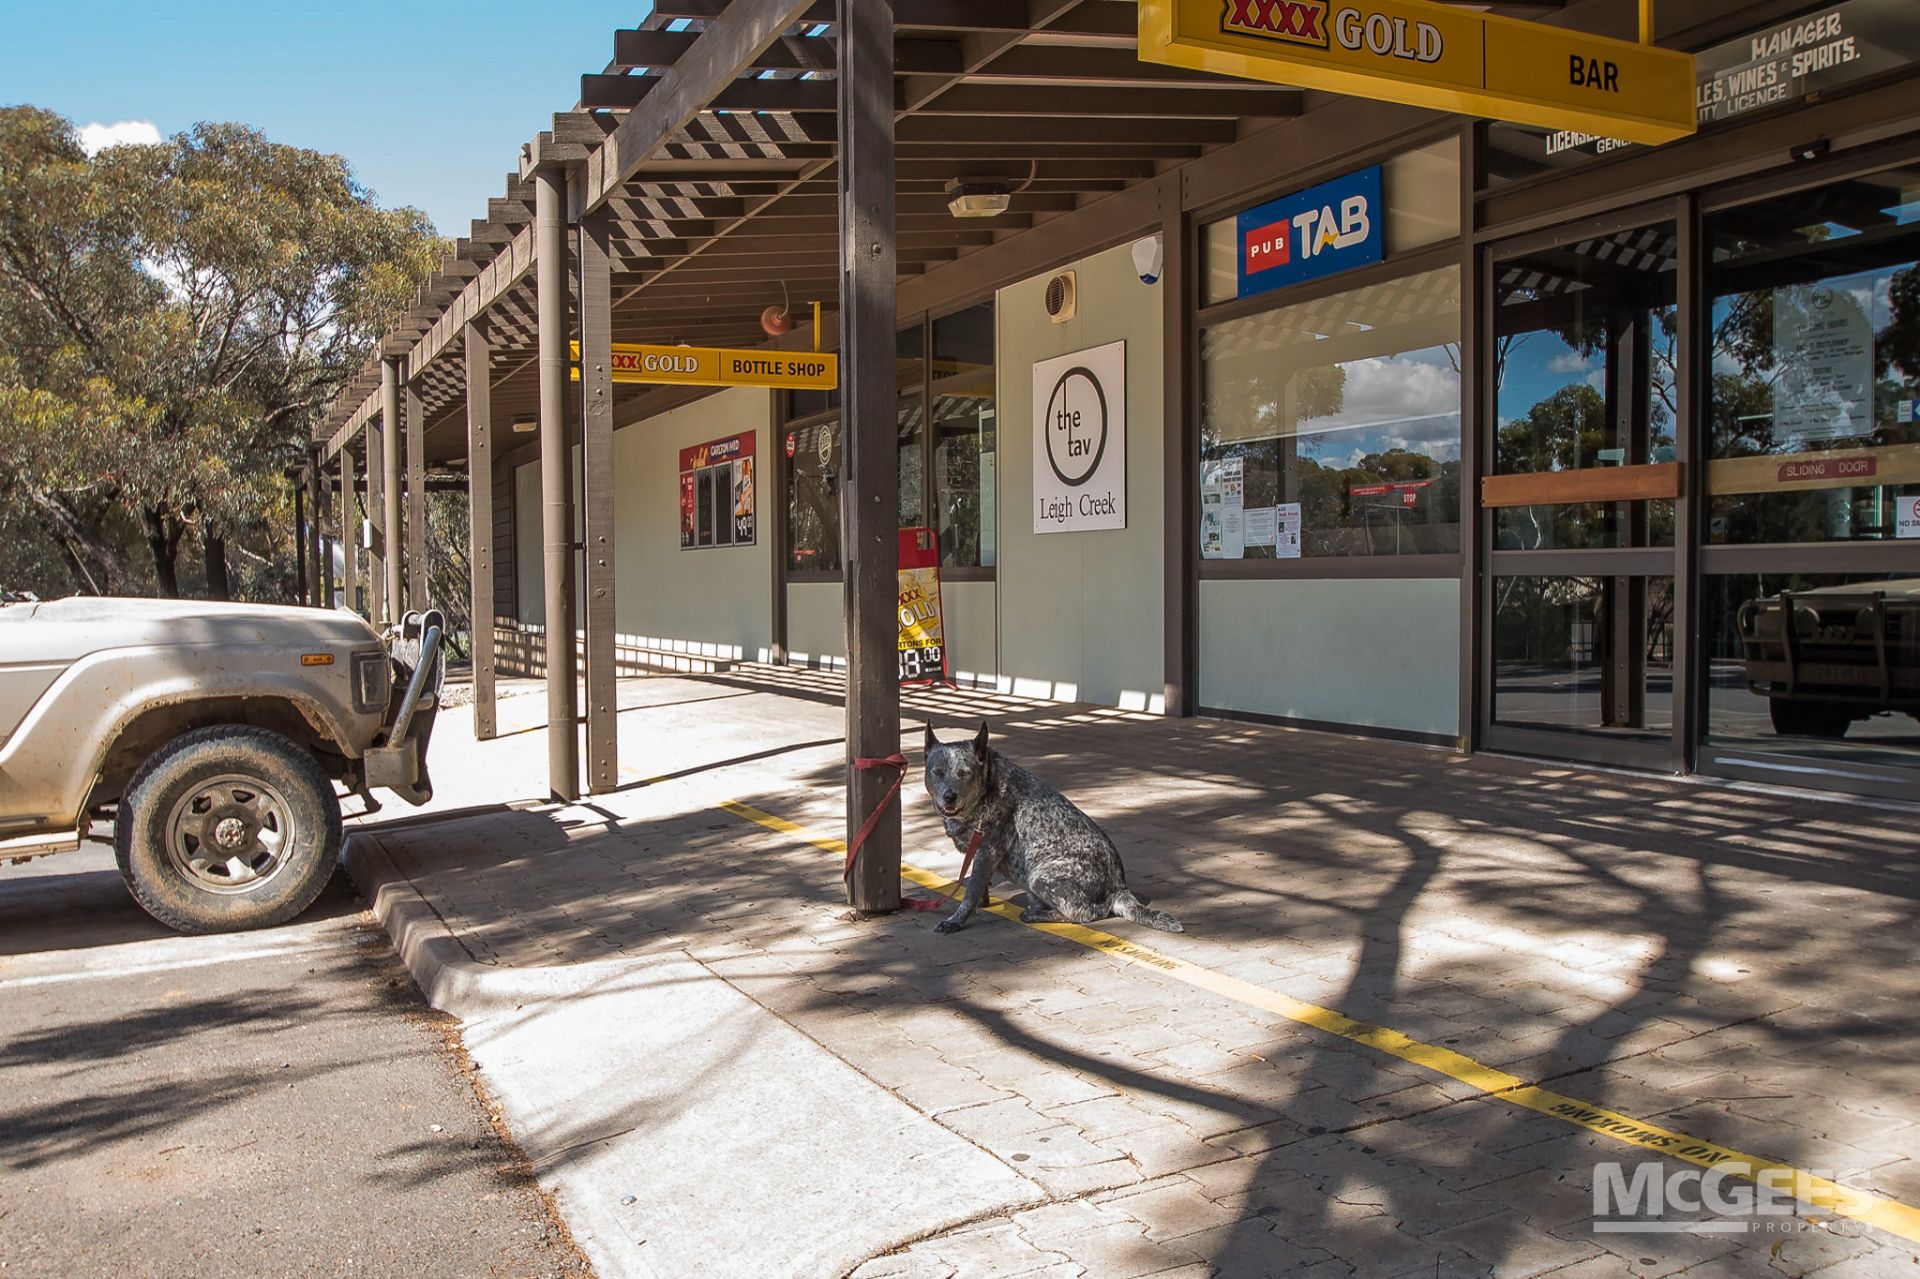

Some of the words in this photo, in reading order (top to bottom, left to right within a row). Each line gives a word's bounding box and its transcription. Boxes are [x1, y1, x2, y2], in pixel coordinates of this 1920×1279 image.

[1230, 0, 1321, 40] XXXX
[1335, 8, 1443, 63] GOLD
[1750, 12, 1842, 62] MANAGER
[1569, 54, 1620, 93] BAR
[1728, 61, 1777, 97] WINES
[1791, 36, 1861, 78] SPIRITS.
[1727, 82, 1787, 114] LICENCE
[1251, 237, 1284, 257] PUB
[1292, 195, 1370, 259] TAB
[644, 354, 698, 373] GOLD
[732, 359, 783, 376] BOTTLE
[787, 361, 826, 377] SHOP
[1057, 380, 1081, 431] the
[1067, 437, 1092, 457] tav
[1786, 463, 1826, 477] SLIDING
[1838, 459, 1869, 473] DOOR
[1040, 496, 1073, 523] Leigh
[1079, 491, 1116, 517] Creek
[898, 600, 935, 635] OLD
[925, 637, 942, 647] FOR
[898, 647, 941, 680] 8.00
